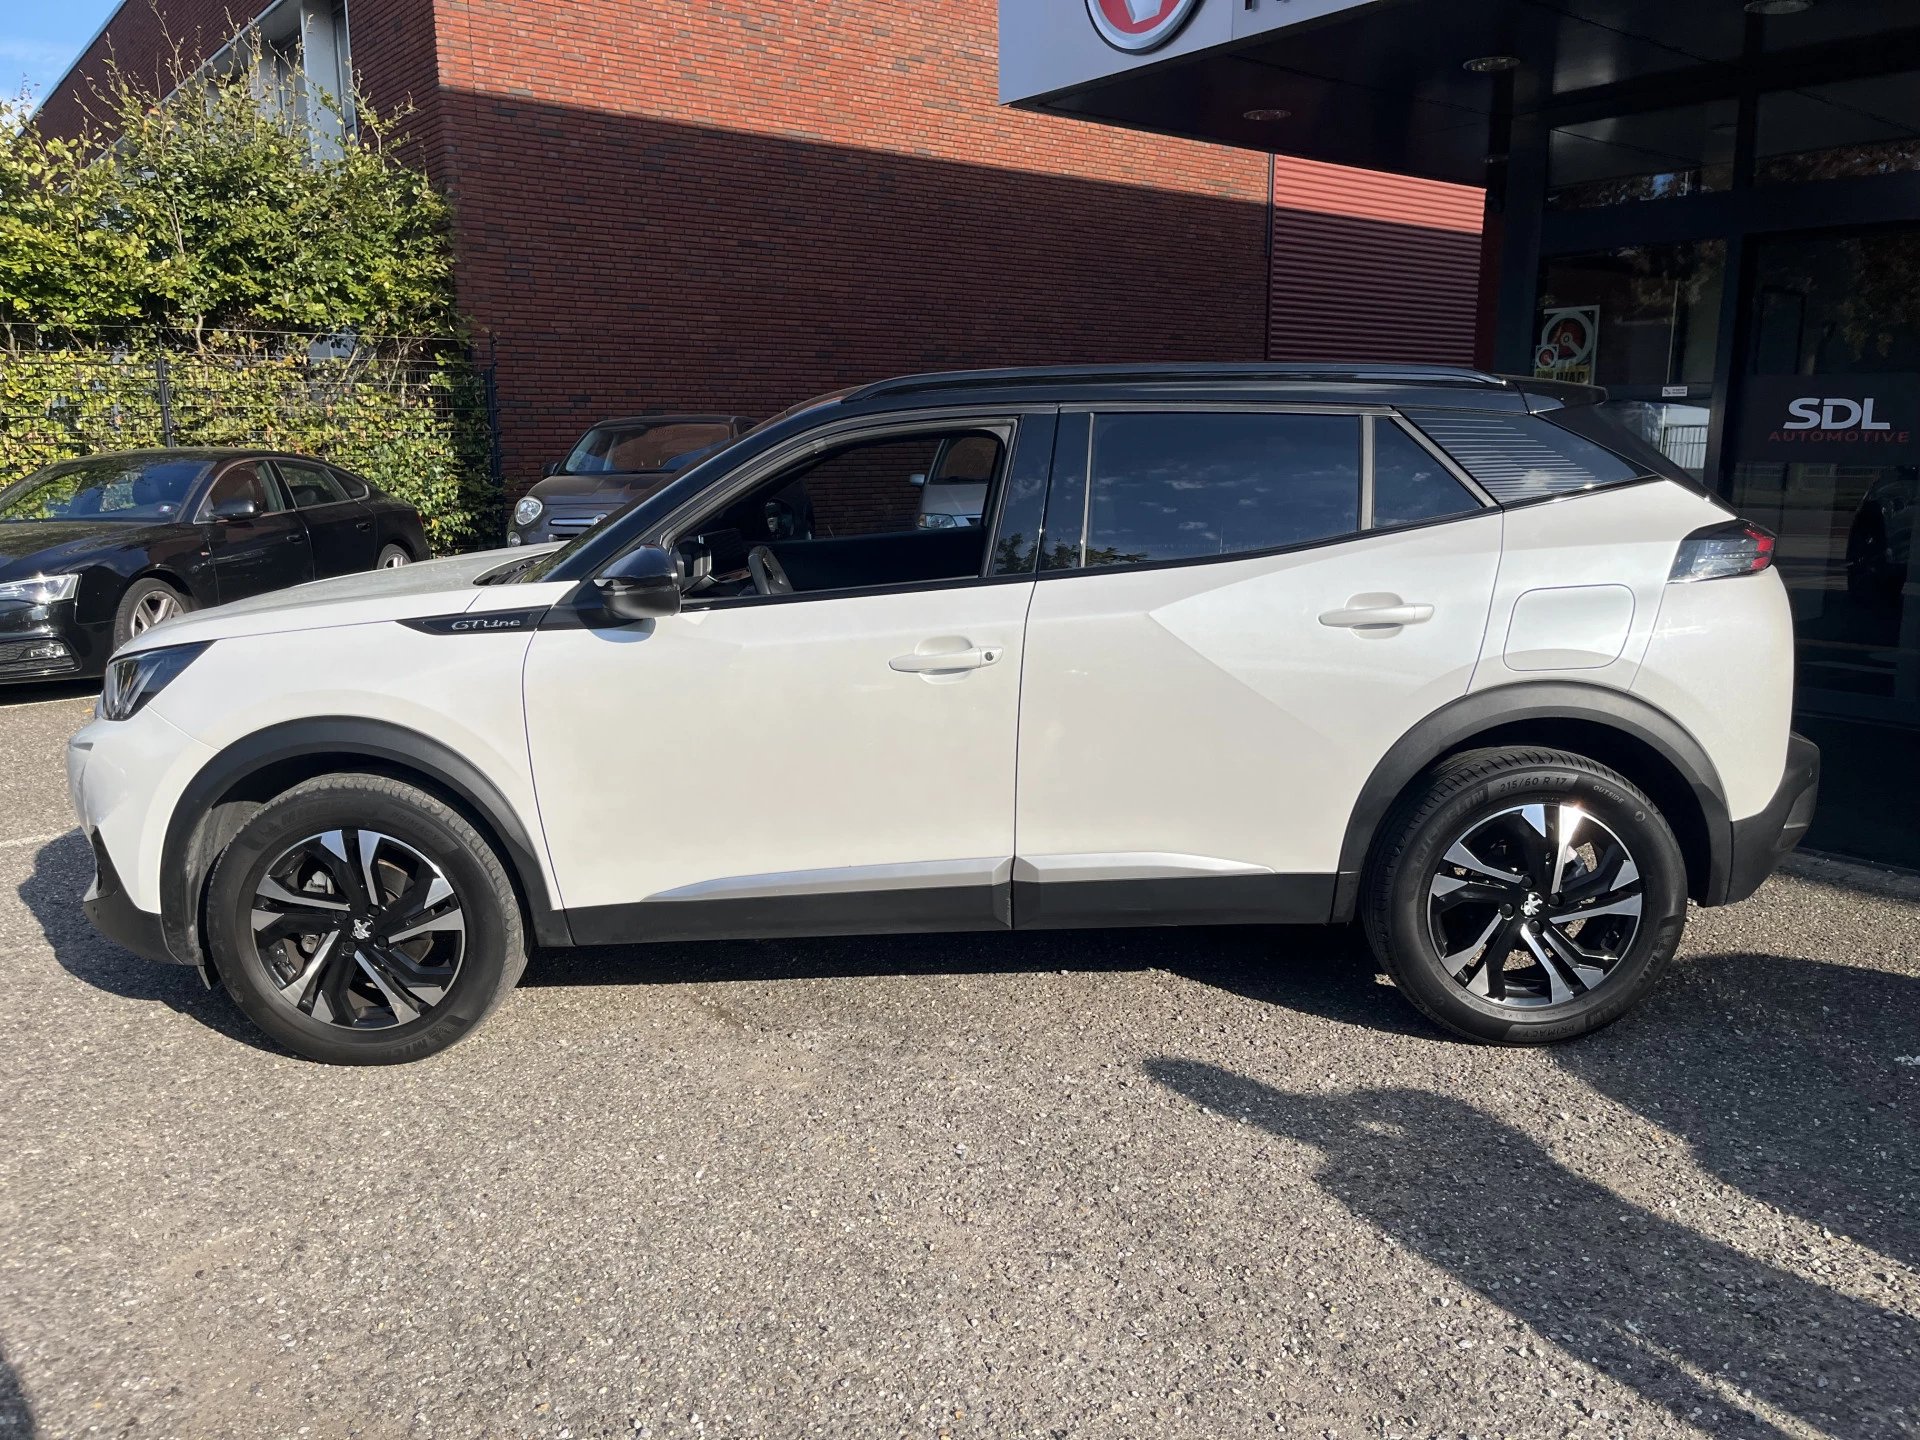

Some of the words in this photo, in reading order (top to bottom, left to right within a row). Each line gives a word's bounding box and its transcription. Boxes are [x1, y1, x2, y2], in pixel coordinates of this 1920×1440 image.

[1783, 397, 1891, 430] SDL
[1768, 431, 1911, 443] AUTOMOTIVE
[1499, 777, 1540, 792] 215/60
[1542, 776, 1551, 786] R
[1555, 776, 1568, 786] 17
[1593, 785, 1625, 804] OUTSIDE
